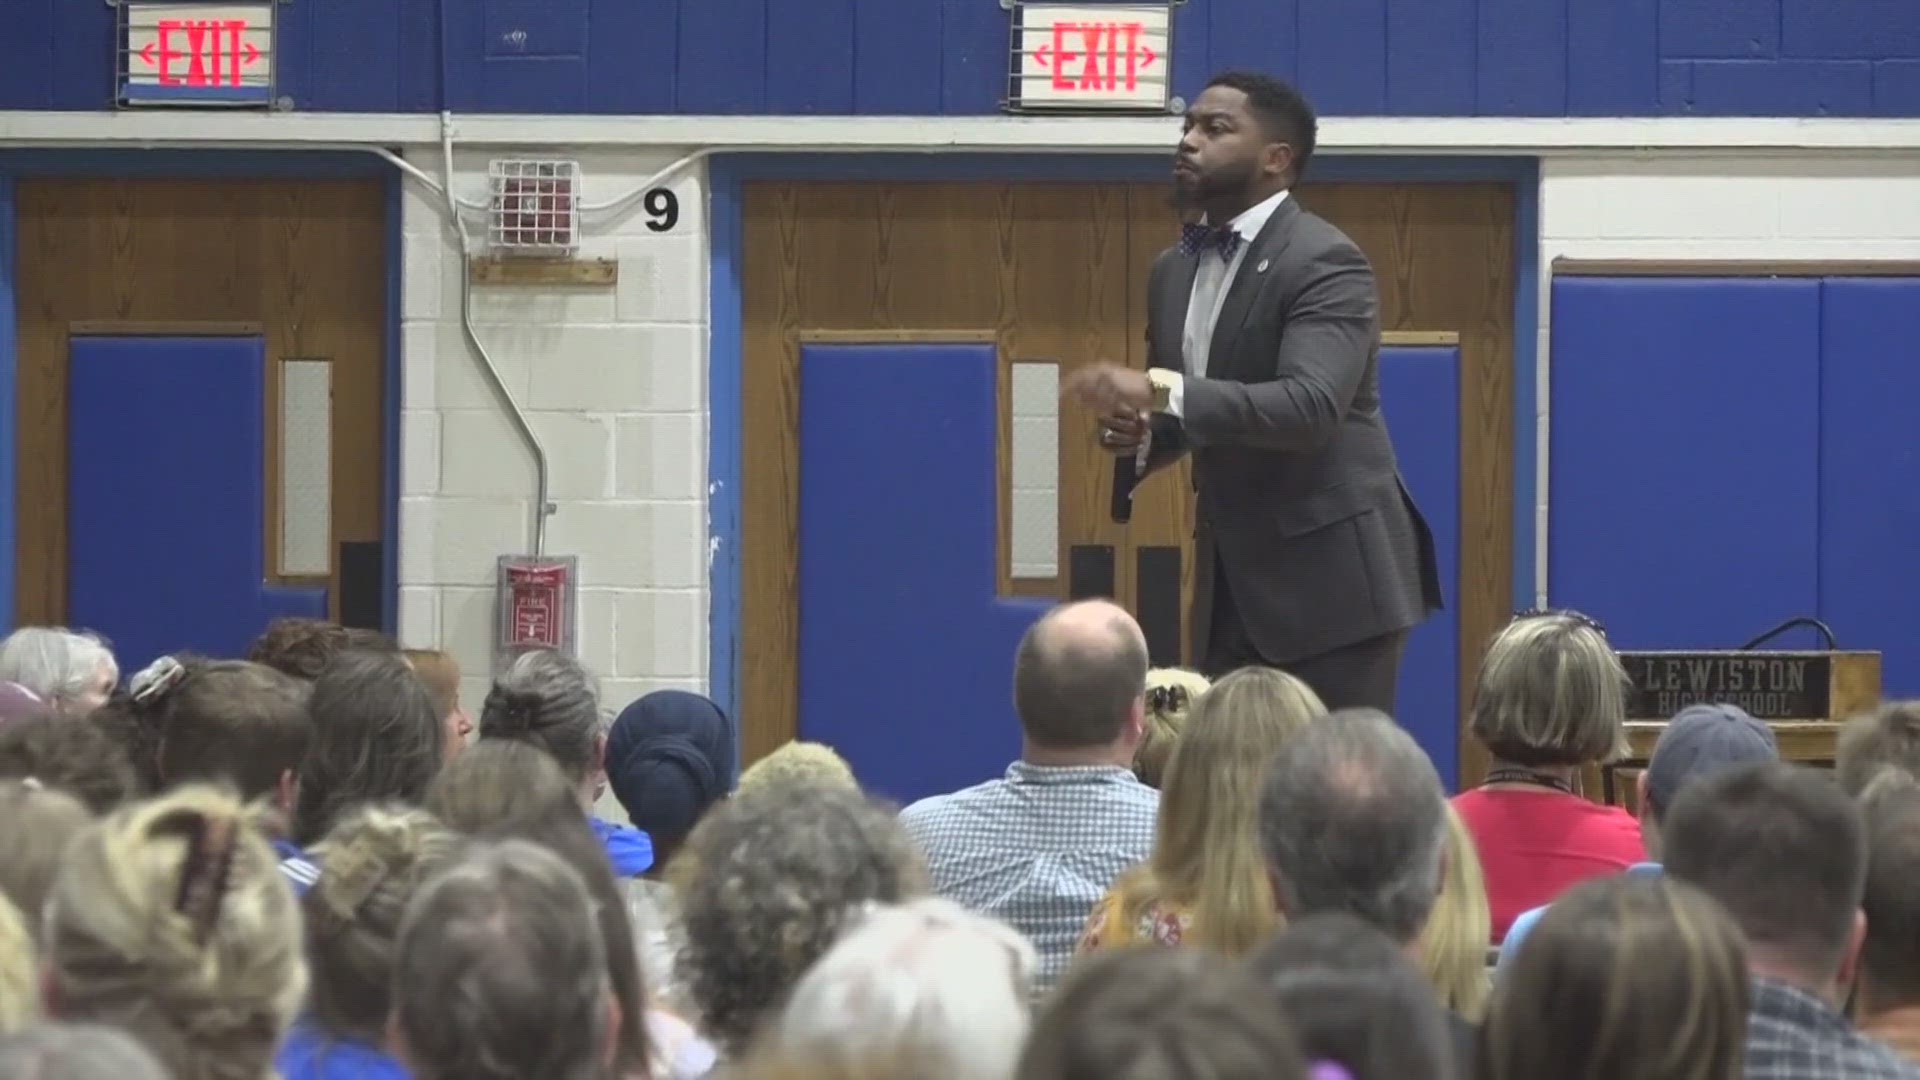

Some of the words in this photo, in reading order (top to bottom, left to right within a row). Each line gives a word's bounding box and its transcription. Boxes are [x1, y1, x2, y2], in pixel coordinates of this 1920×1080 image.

[158, 20, 246, 87] EXIT
[1052, 22, 1144, 91] EXIT
[644, 187, 679, 232] 9
[1645, 659, 1807, 692] LEWISTON
